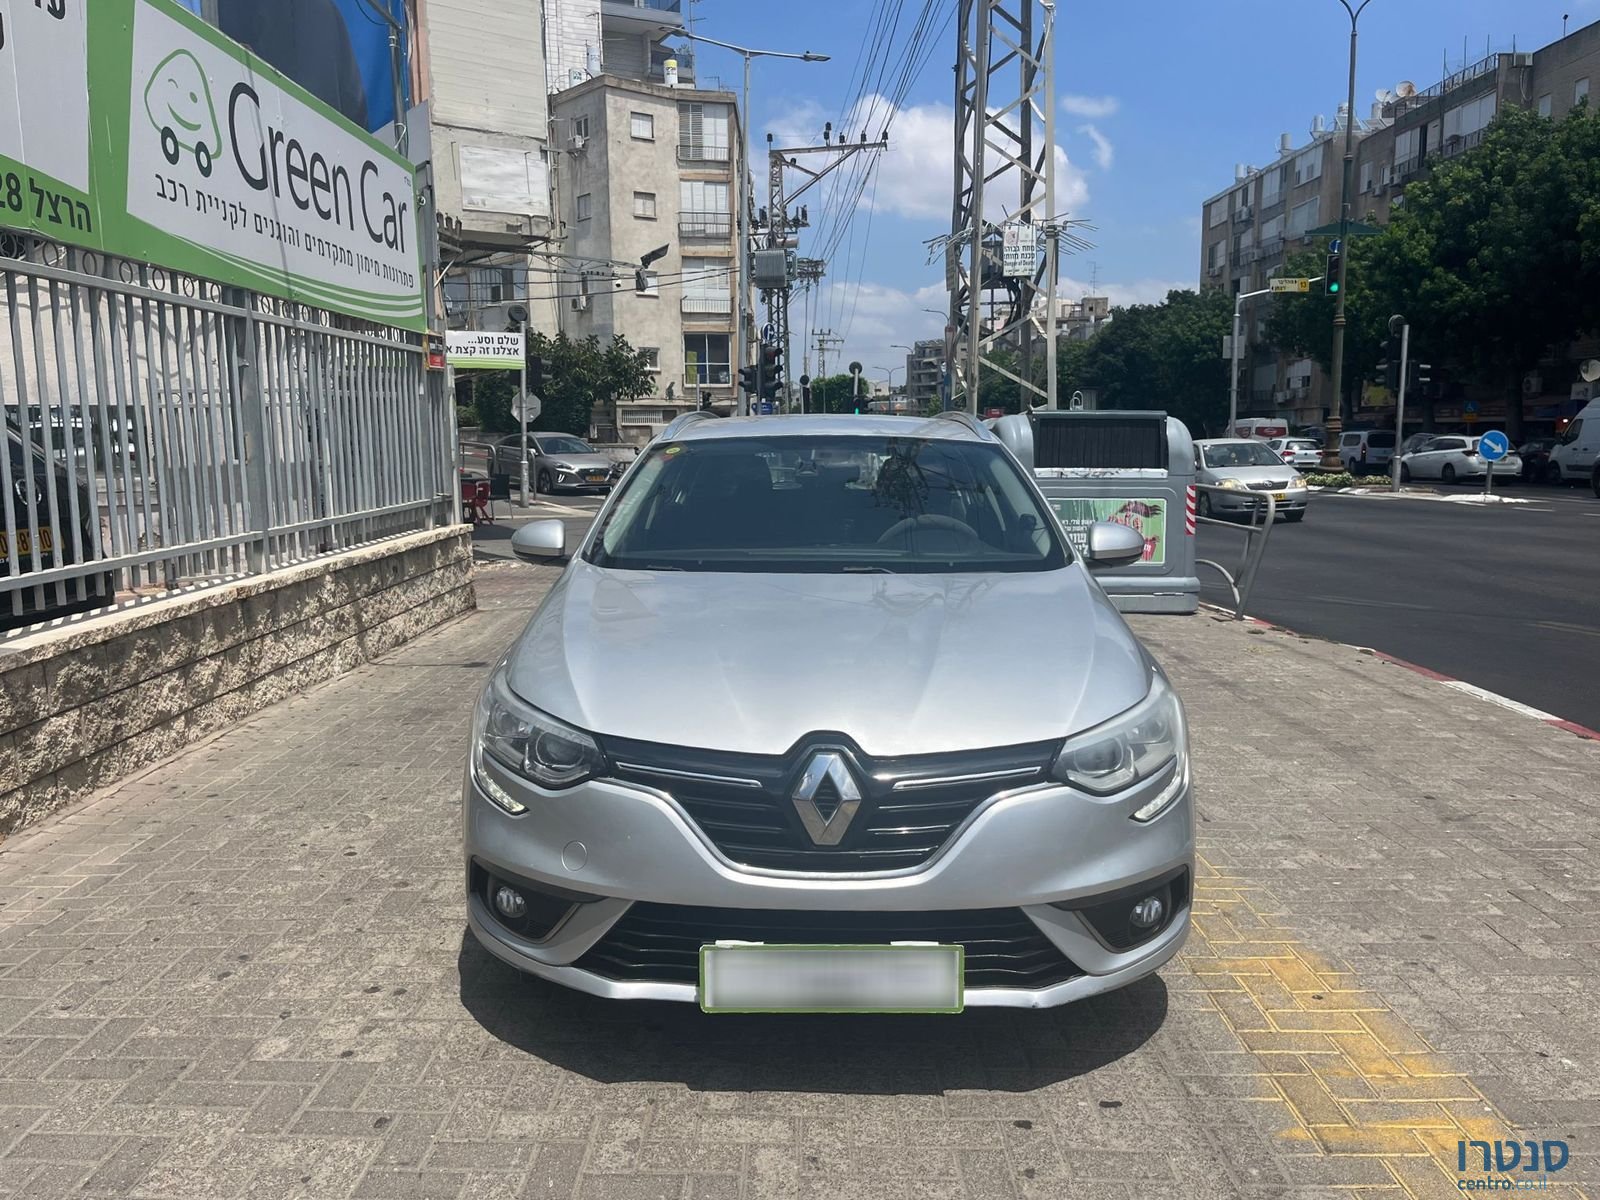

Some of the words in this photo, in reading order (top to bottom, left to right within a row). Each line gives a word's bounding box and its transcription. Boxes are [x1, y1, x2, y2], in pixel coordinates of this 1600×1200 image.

[228, 82, 355, 231] Green
[360, 159, 407, 253] Car
[29, 176, 92, 233] הרצל
[155, 173, 189, 207] רכב
[196, 189, 247, 231] לקניית
[254, 212, 300, 248] והוגנים
[305, 232, 353, 267] מתקדמים
[356, 252, 380, 275] מימון
[383, 263, 414, 289] פתרונות
[455, 345, 476, 356] קצת
[479, 346, 490, 355] זה
[493, 345, 519, 356] אצלנו
[498, 335, 519, 346] שלם
